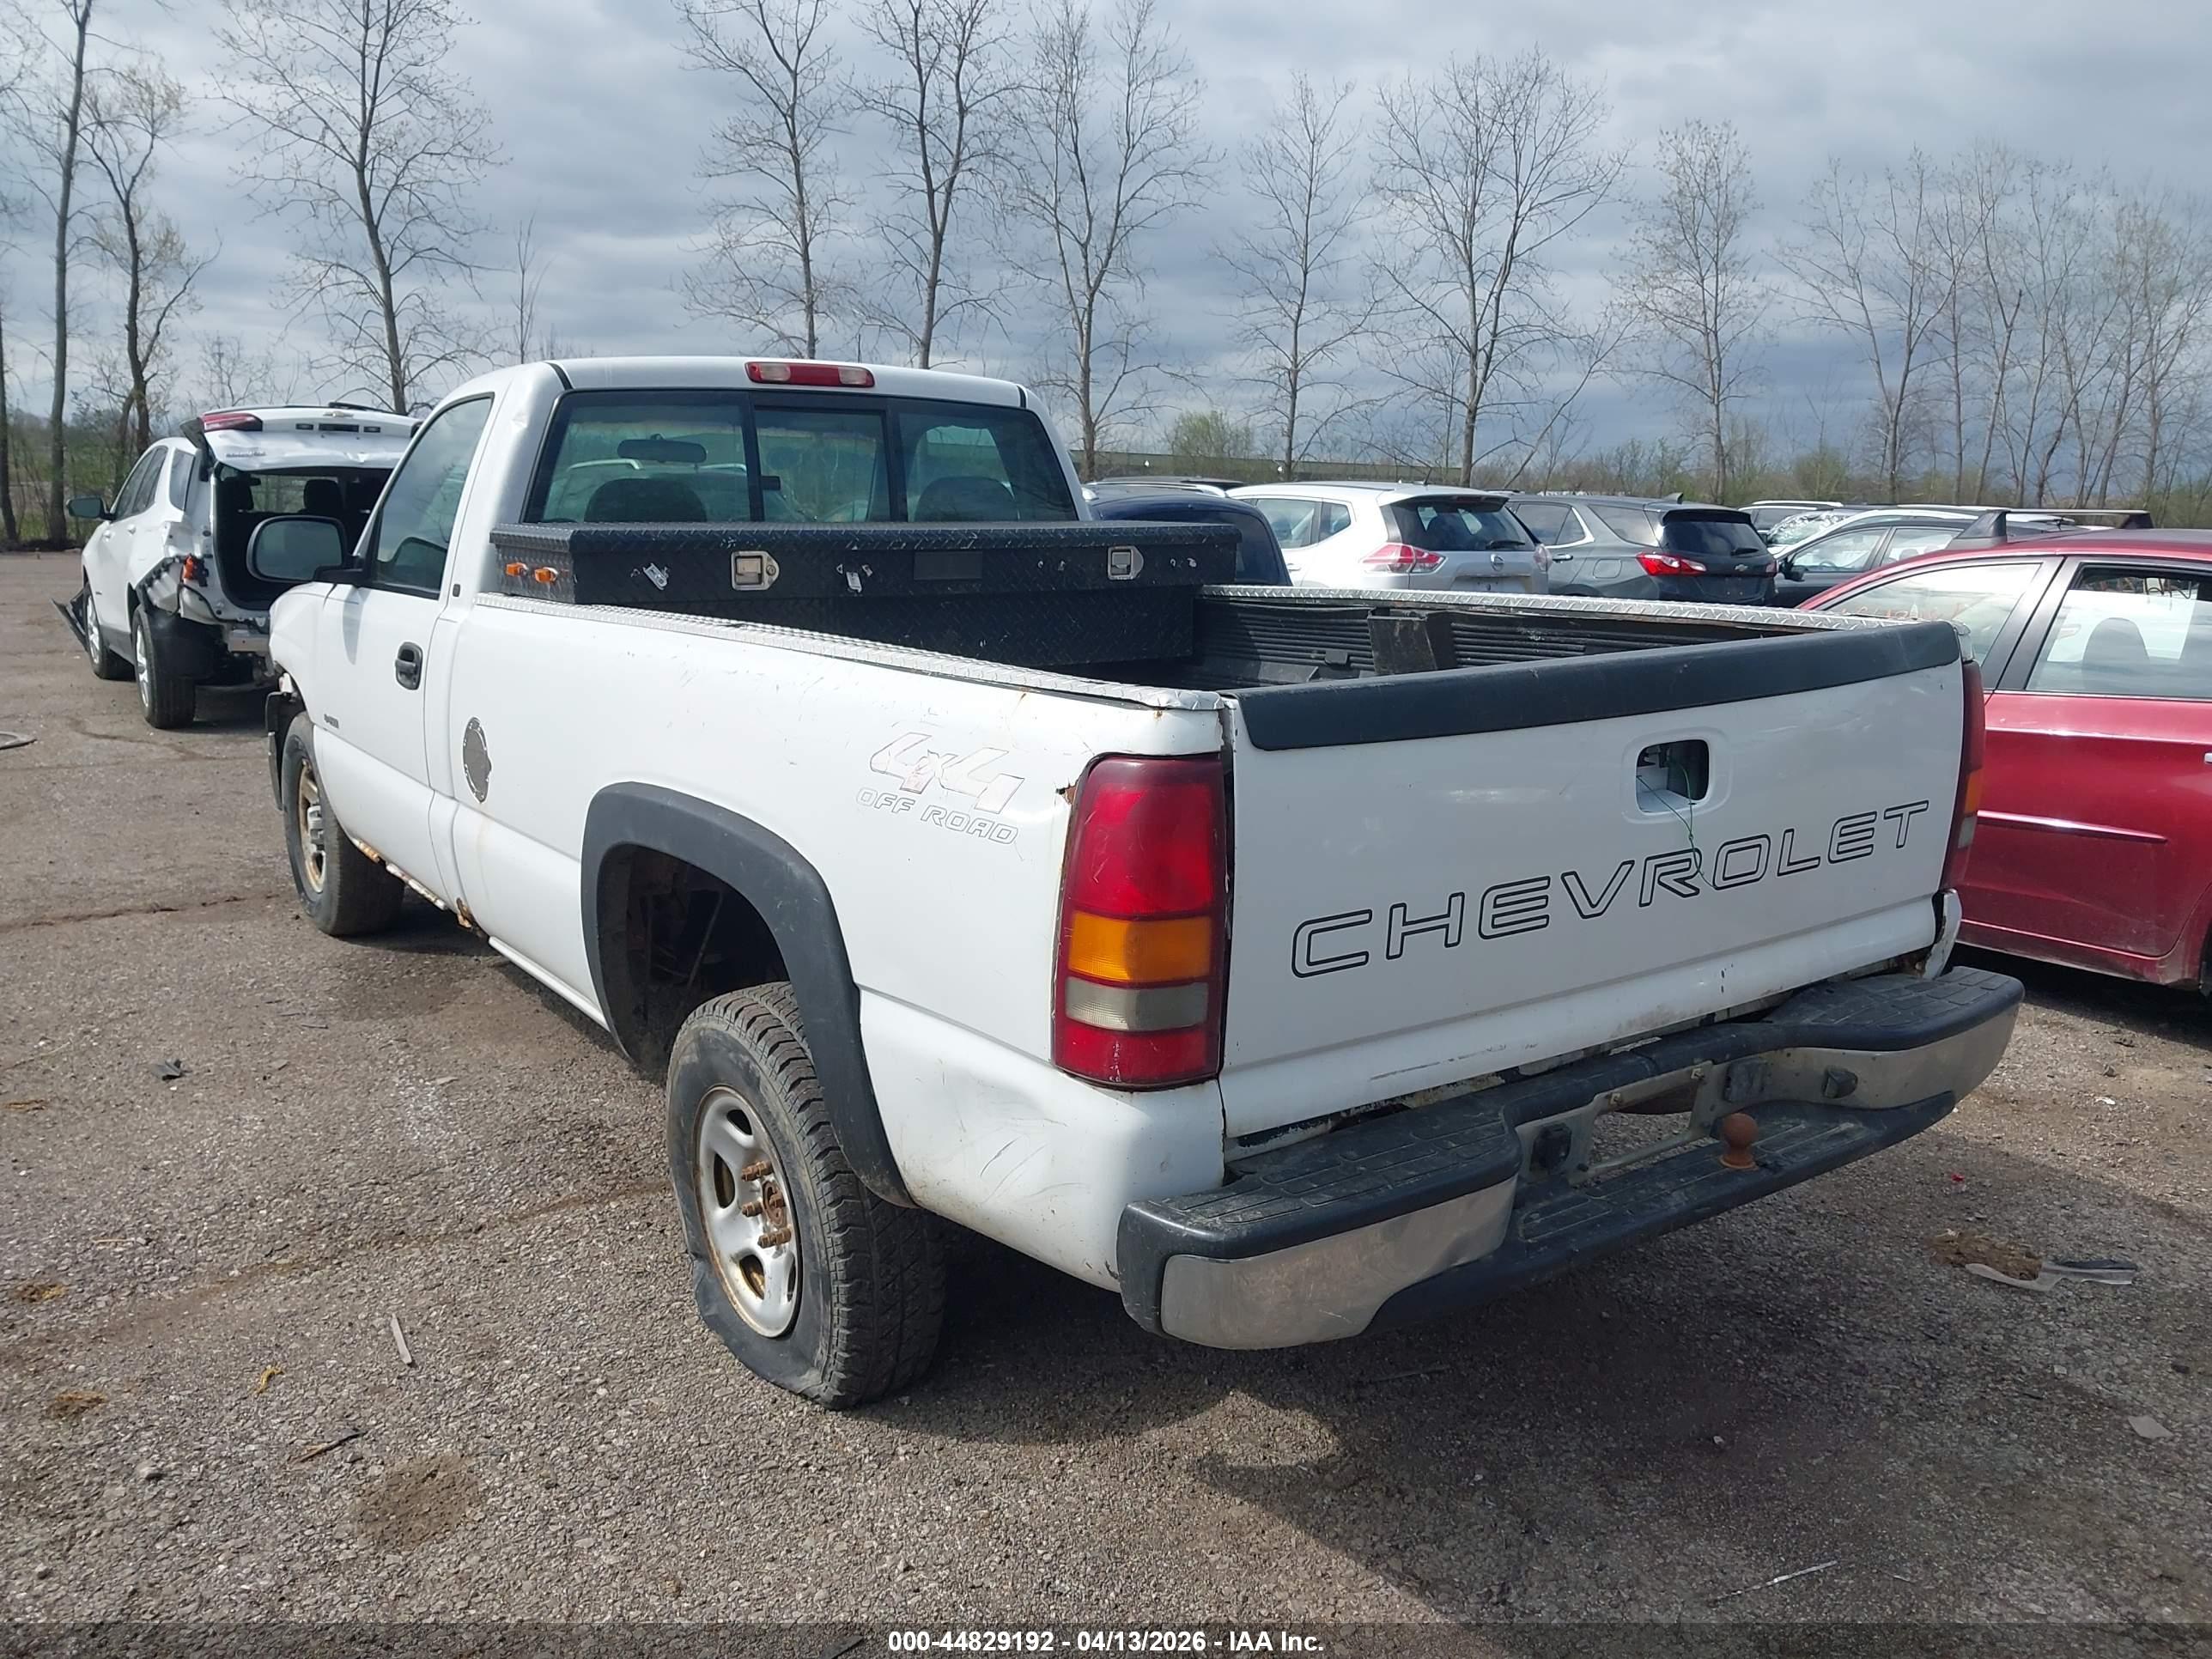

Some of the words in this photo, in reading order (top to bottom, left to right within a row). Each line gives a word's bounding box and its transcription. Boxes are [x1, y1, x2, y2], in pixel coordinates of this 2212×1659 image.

[857, 787, 915, 813] OFF
[921, 805, 1018, 844] ROAD
[1291, 800, 1929, 978] CHEVROLET
